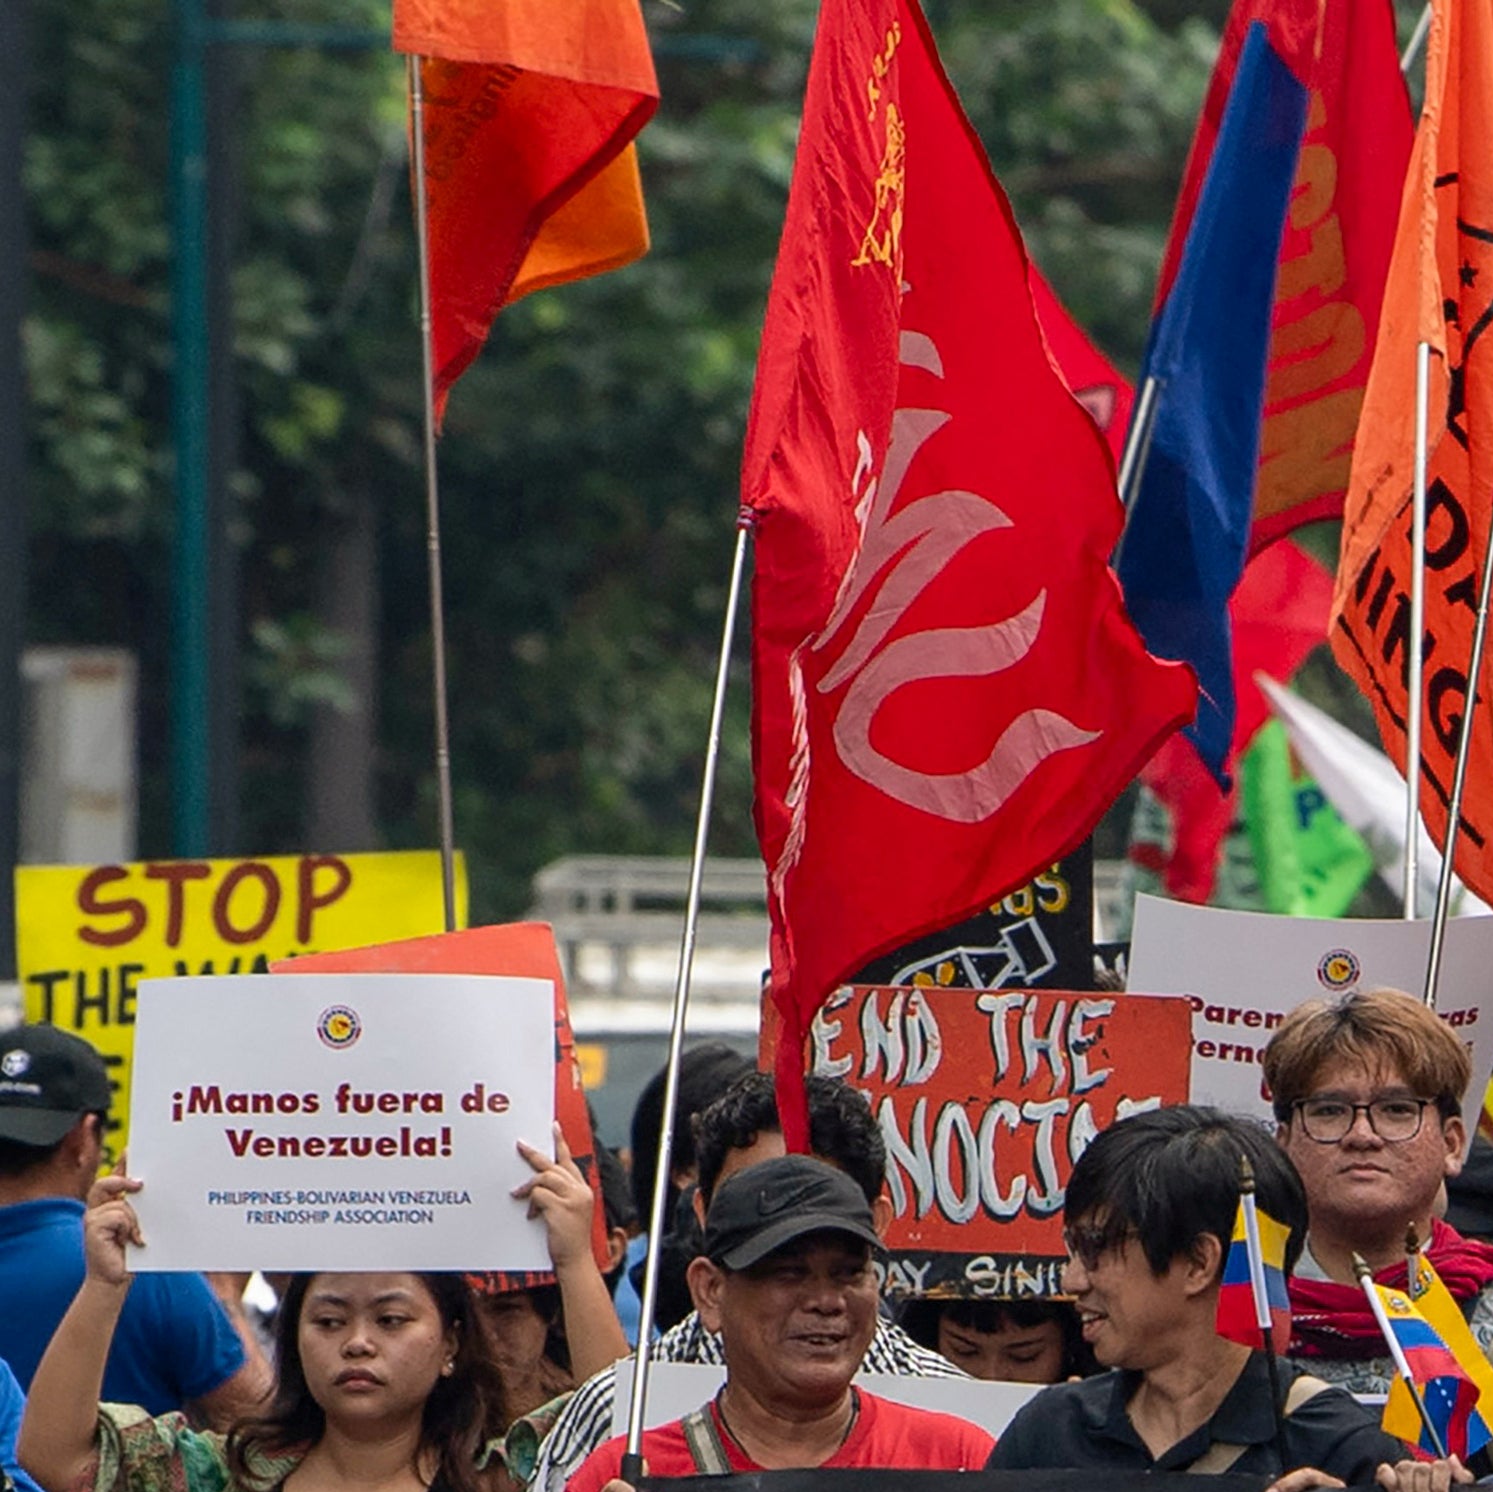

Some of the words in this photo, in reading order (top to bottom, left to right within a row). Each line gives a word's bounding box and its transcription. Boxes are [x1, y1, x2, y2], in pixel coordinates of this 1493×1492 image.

[76, 856, 353, 949] STOP
[811, 985, 942, 1088] END
[976, 992, 1118, 1096] THE
[172, 1085, 320, 1122] ¡Manos
[335, 1083, 444, 1114] fuera
[461, 1083, 510, 1114] de
[225, 1127, 454, 1157] Venezuela!
[208, 1190, 385, 1206] PHILIPPINES-BOLIVARIAN
[388, 1190, 472, 1206] VENEZUELA
[246, 1210, 330, 1225] FRIENDSHIP
[334, 1210, 434, 1225] ASSOCIATION
